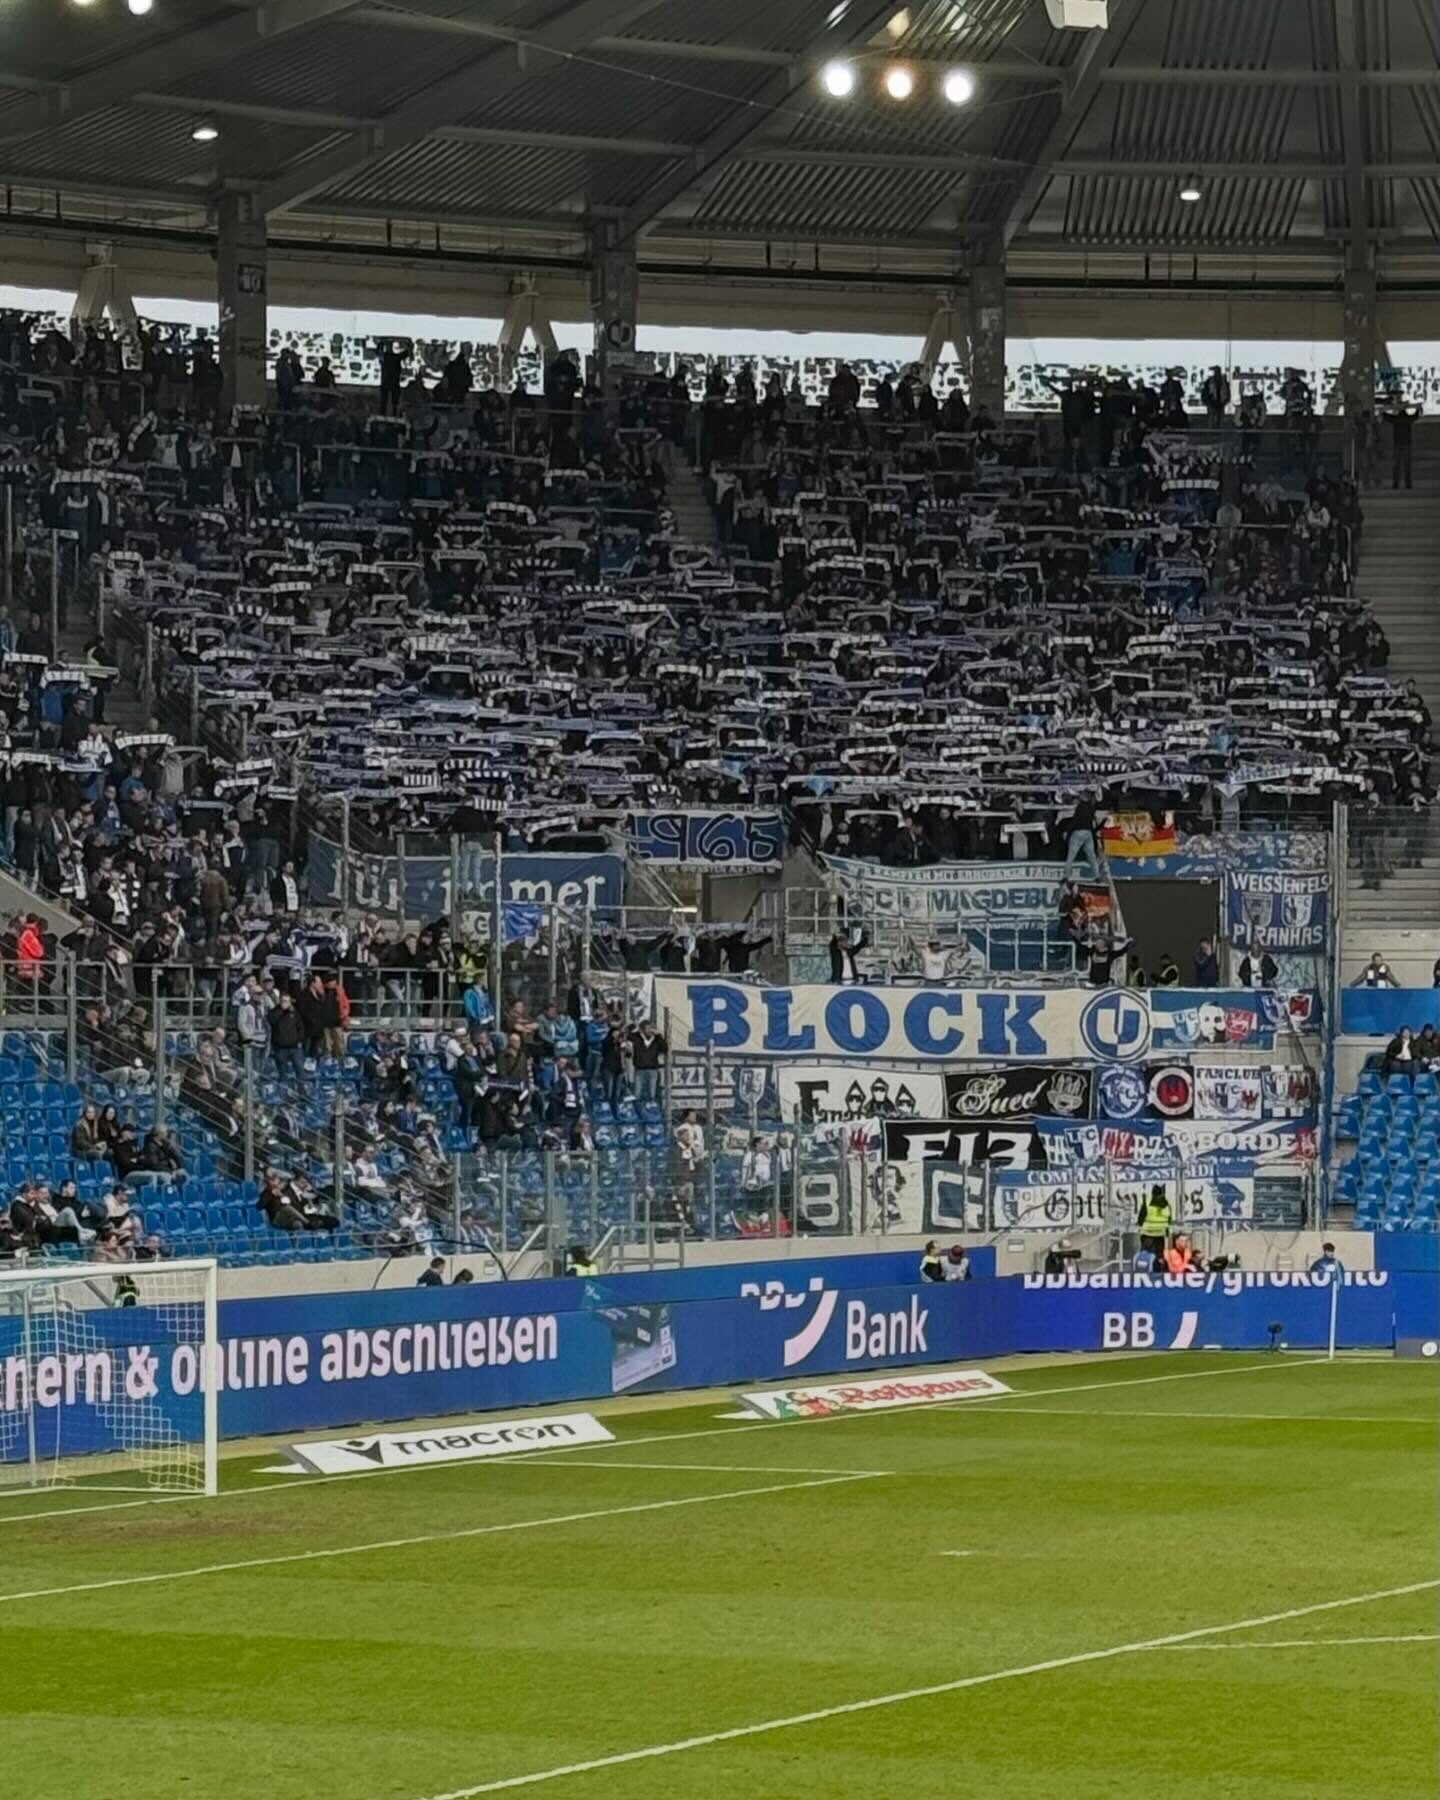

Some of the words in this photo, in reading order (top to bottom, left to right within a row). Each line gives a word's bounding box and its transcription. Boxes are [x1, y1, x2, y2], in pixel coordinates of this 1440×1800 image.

[1230, 871, 1332, 893] WEISSENFELS
[927, 887, 1059, 913] MAGDEBU
[1232, 922, 1323, 947] PIRANHAS
[687, 984, 1047, 1055] BLOCK
[1196, 1067, 1261, 1081] FANCLUB
[846, 1294, 928, 1360] Bank
[1102, 1312, 1155, 1349] BB
[0, 1352, 111, 1412] nern
[126, 1346, 159, 1400] &
[827, 1378, 993, 1404] Rothaus
[391, 1423, 576, 1456] macron
